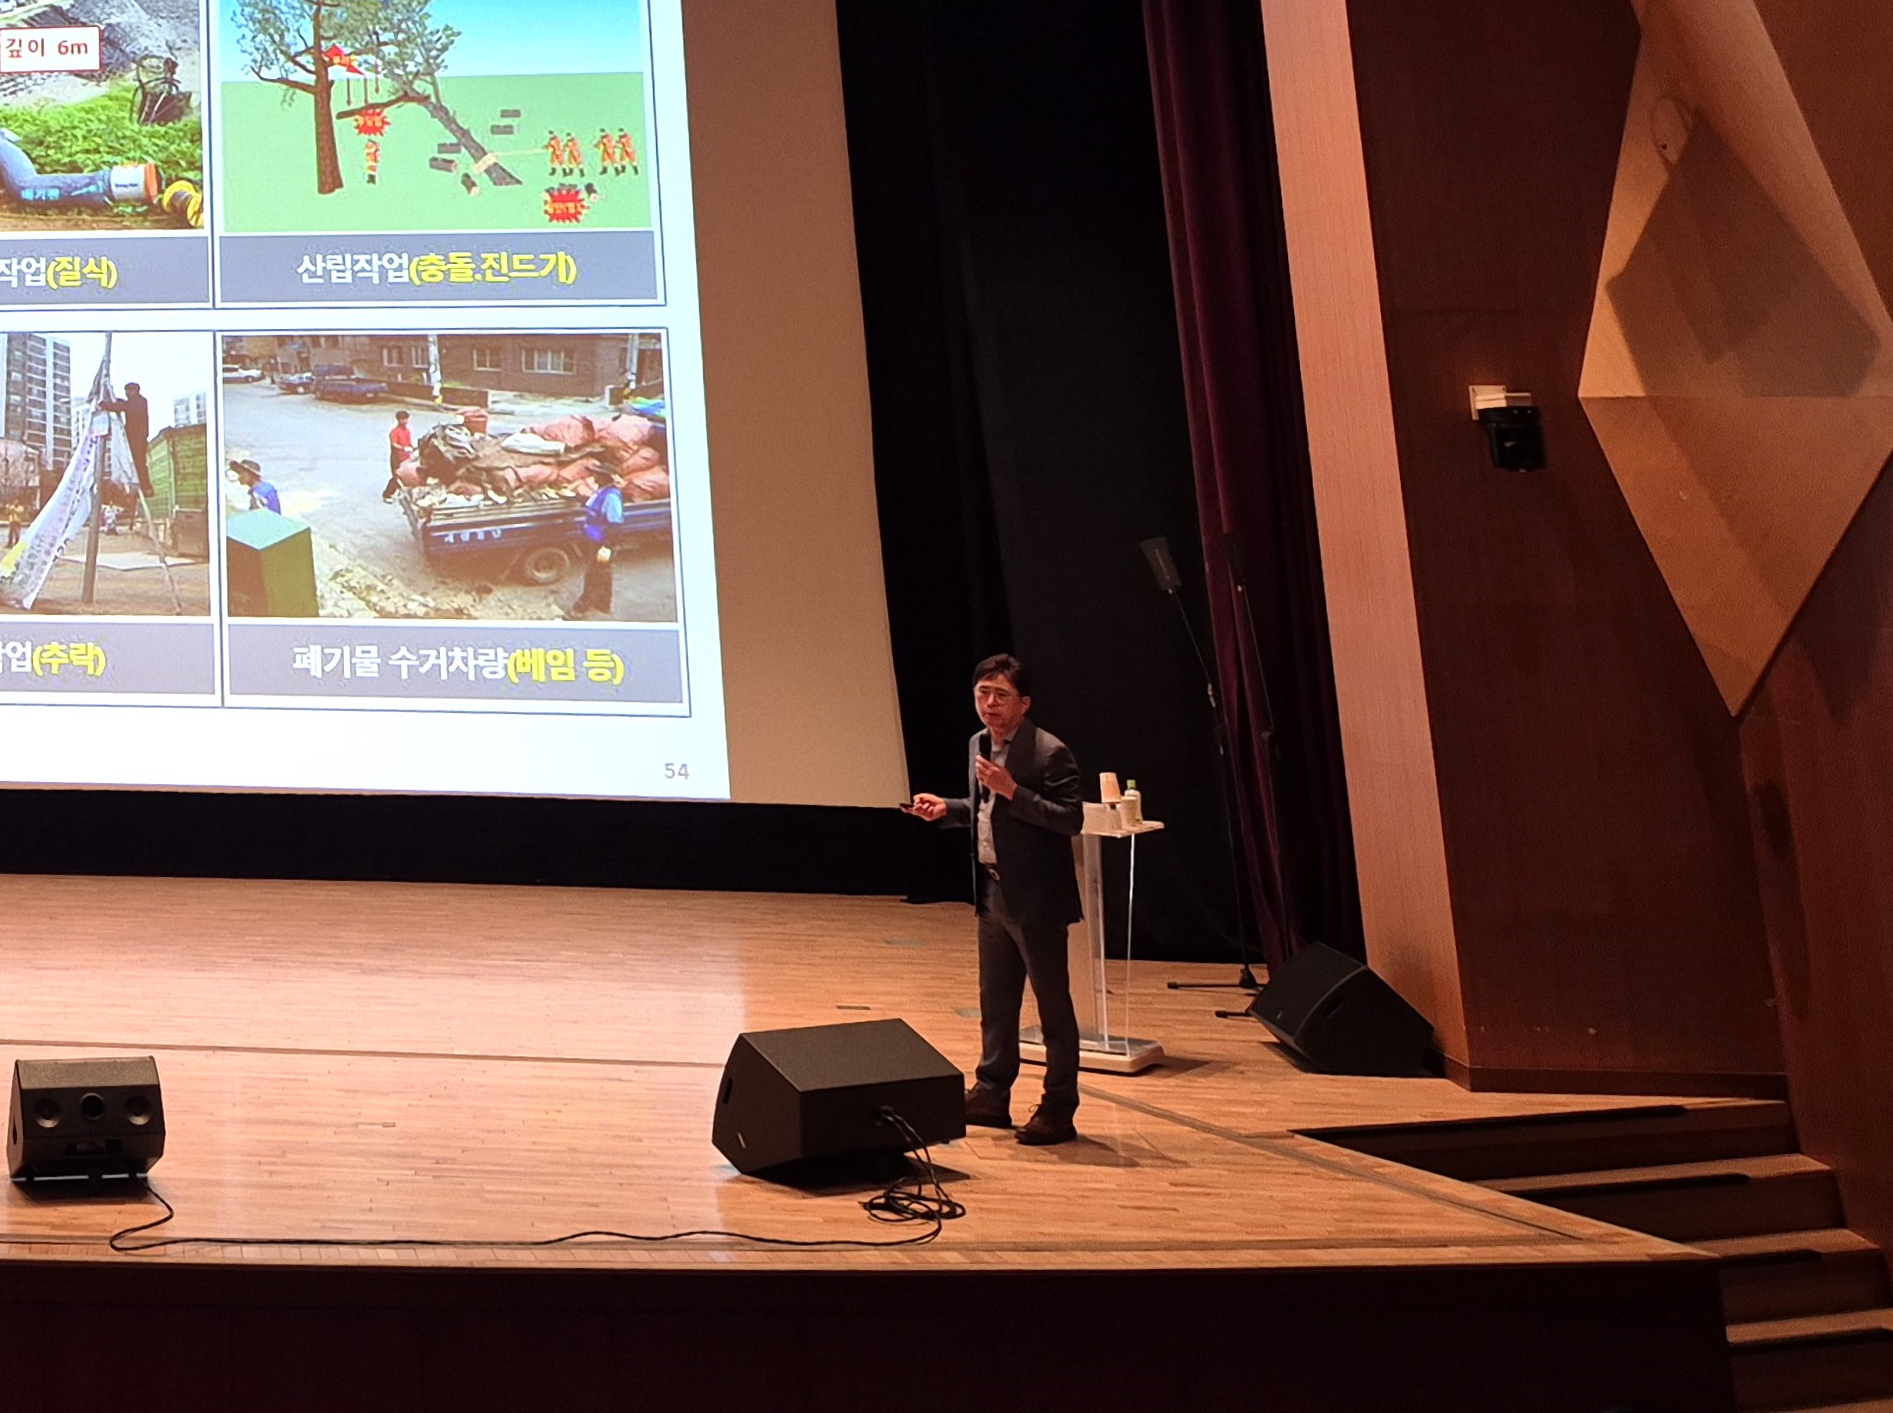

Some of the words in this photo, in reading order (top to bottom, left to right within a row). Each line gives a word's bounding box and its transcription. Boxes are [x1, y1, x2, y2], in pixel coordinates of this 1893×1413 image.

[6, 38, 45, 58] 깊이
[58, 40, 88, 55] 6m
[297, 251, 577, 285] 산림작업(충돌.진드기)
[292, 645, 380, 678] 폐기물
[388, 646, 575, 684] 수거차량(베임
[582, 649, 625, 685] 등)
[664, 763, 690, 780] 54
